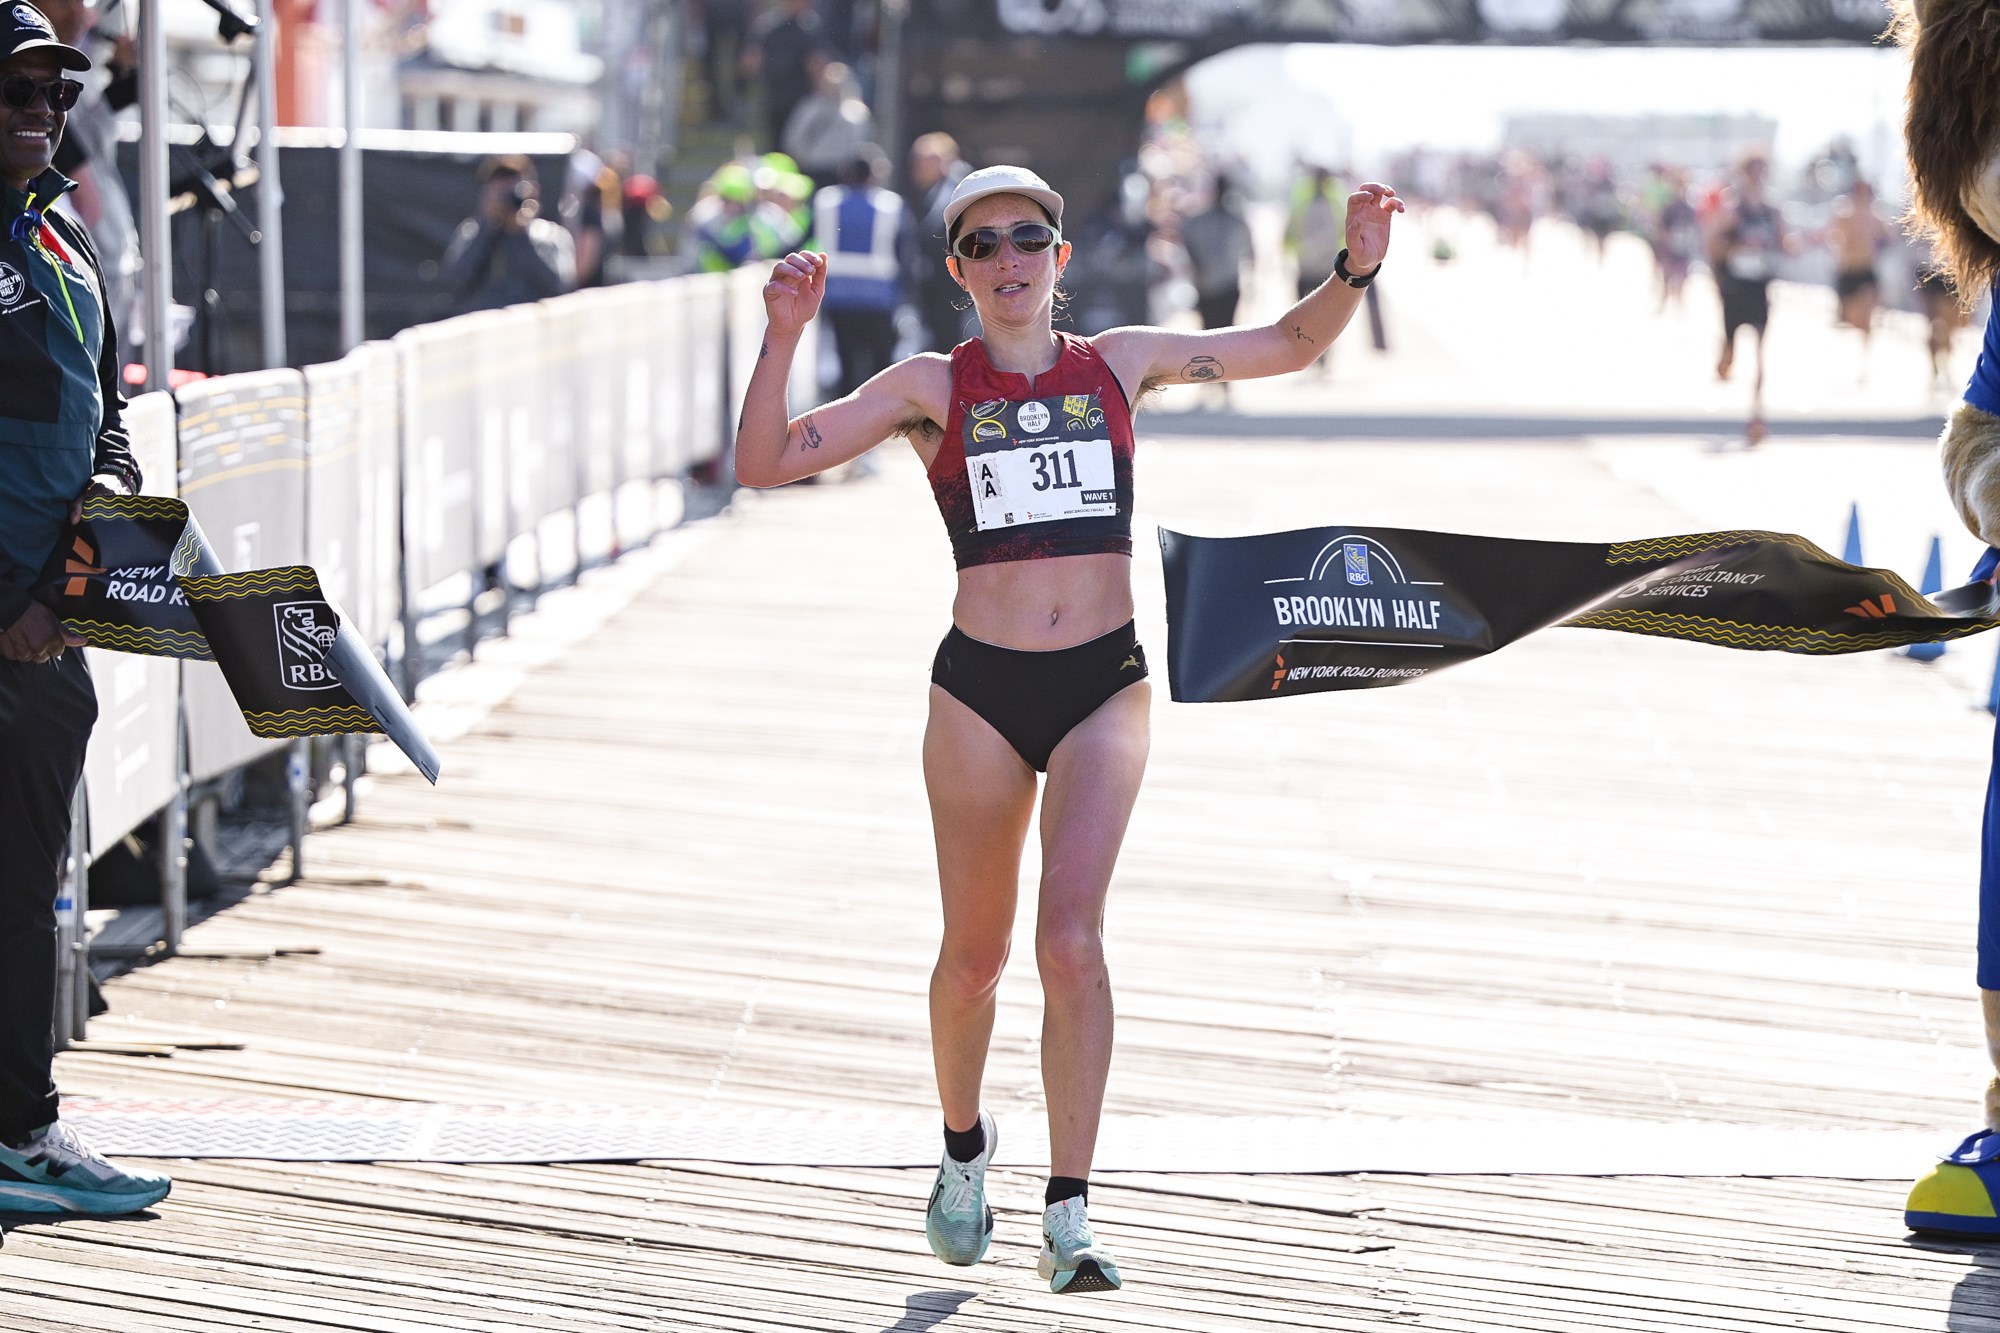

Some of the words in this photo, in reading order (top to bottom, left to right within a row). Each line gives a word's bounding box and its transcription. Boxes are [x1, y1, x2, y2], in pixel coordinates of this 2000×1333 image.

[0, 273, 21, 290] OKLYN
[0, 284, 14, 298] HALF
[1019, 412, 1049, 422] BROOKLYN
[1027, 419, 1041, 428] HALF
[981, 463, 993, 480] A
[1029, 449, 1082, 491] 311
[985, 480, 997, 498] A
[1083, 492, 1108, 502] WAVE
[1108, 492, 1113, 500] 1
[109, 565, 165, 580] NEW
[1349, 572, 1367, 582] RBC
[1661, 570, 1765, 585] CONSULTANCY
[105, 580, 166, 603] ROAD
[1642, 584, 1712, 598] SERVICES
[1273, 595, 1385, 628] BROOKLYN
[1392, 599, 1441, 630] HALF
[1287, 666, 1311, 681] NEW
[1310, 665, 1342, 679] YORK
[1340, 666, 1375, 678] ROAD
[1373, 668, 1428, 678] RUNNERS
